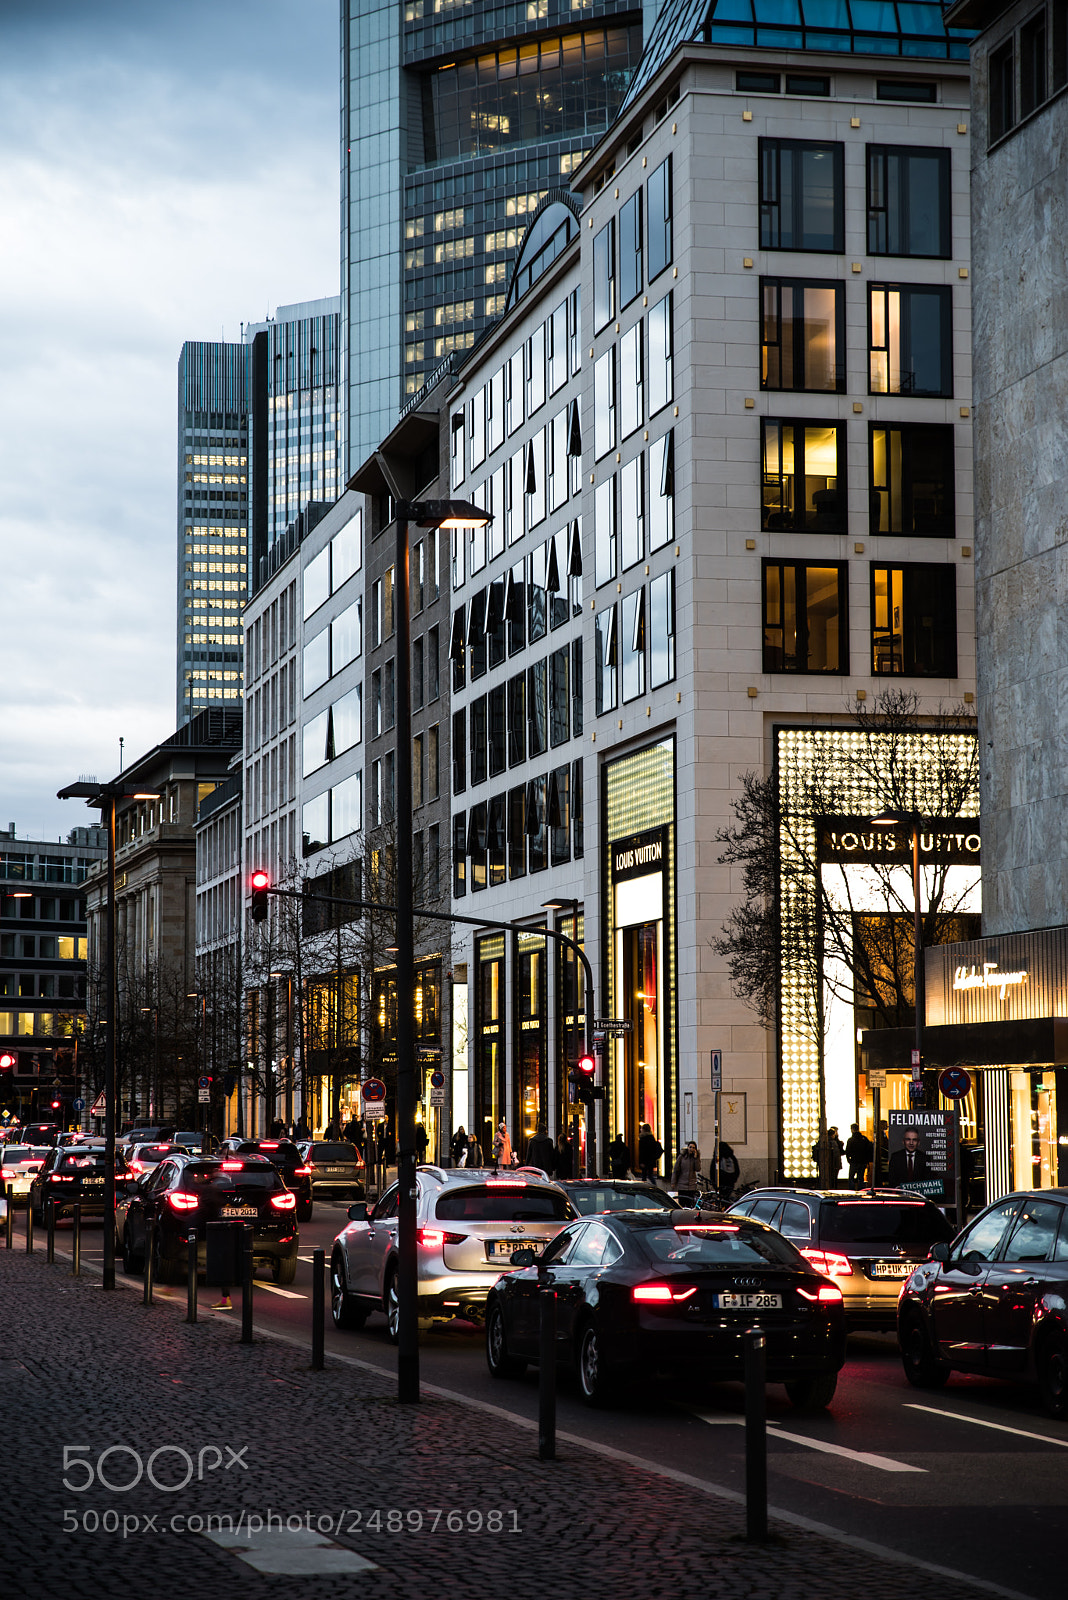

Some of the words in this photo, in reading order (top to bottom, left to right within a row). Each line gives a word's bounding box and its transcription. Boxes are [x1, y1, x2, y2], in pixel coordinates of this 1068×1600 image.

[831, 832, 896, 851] LOUIS
[909, 833, 982, 852] UITTO
[616, 850, 634, 871] LOUIS
[634, 841, 662, 866] VUITTON
[890, 1113, 944, 1126] FELDMANN
[901, 1180, 942, 1190] STICHWAHL
[499, 1243, 506, 1253] F
[876, 1264, 887, 1274] HP
[892, 1264, 903, 1274] UK
[722, 1295, 731, 1307] F
[739, 1295, 753, 1307] IF
[755, 1295, 778, 1307] 285
